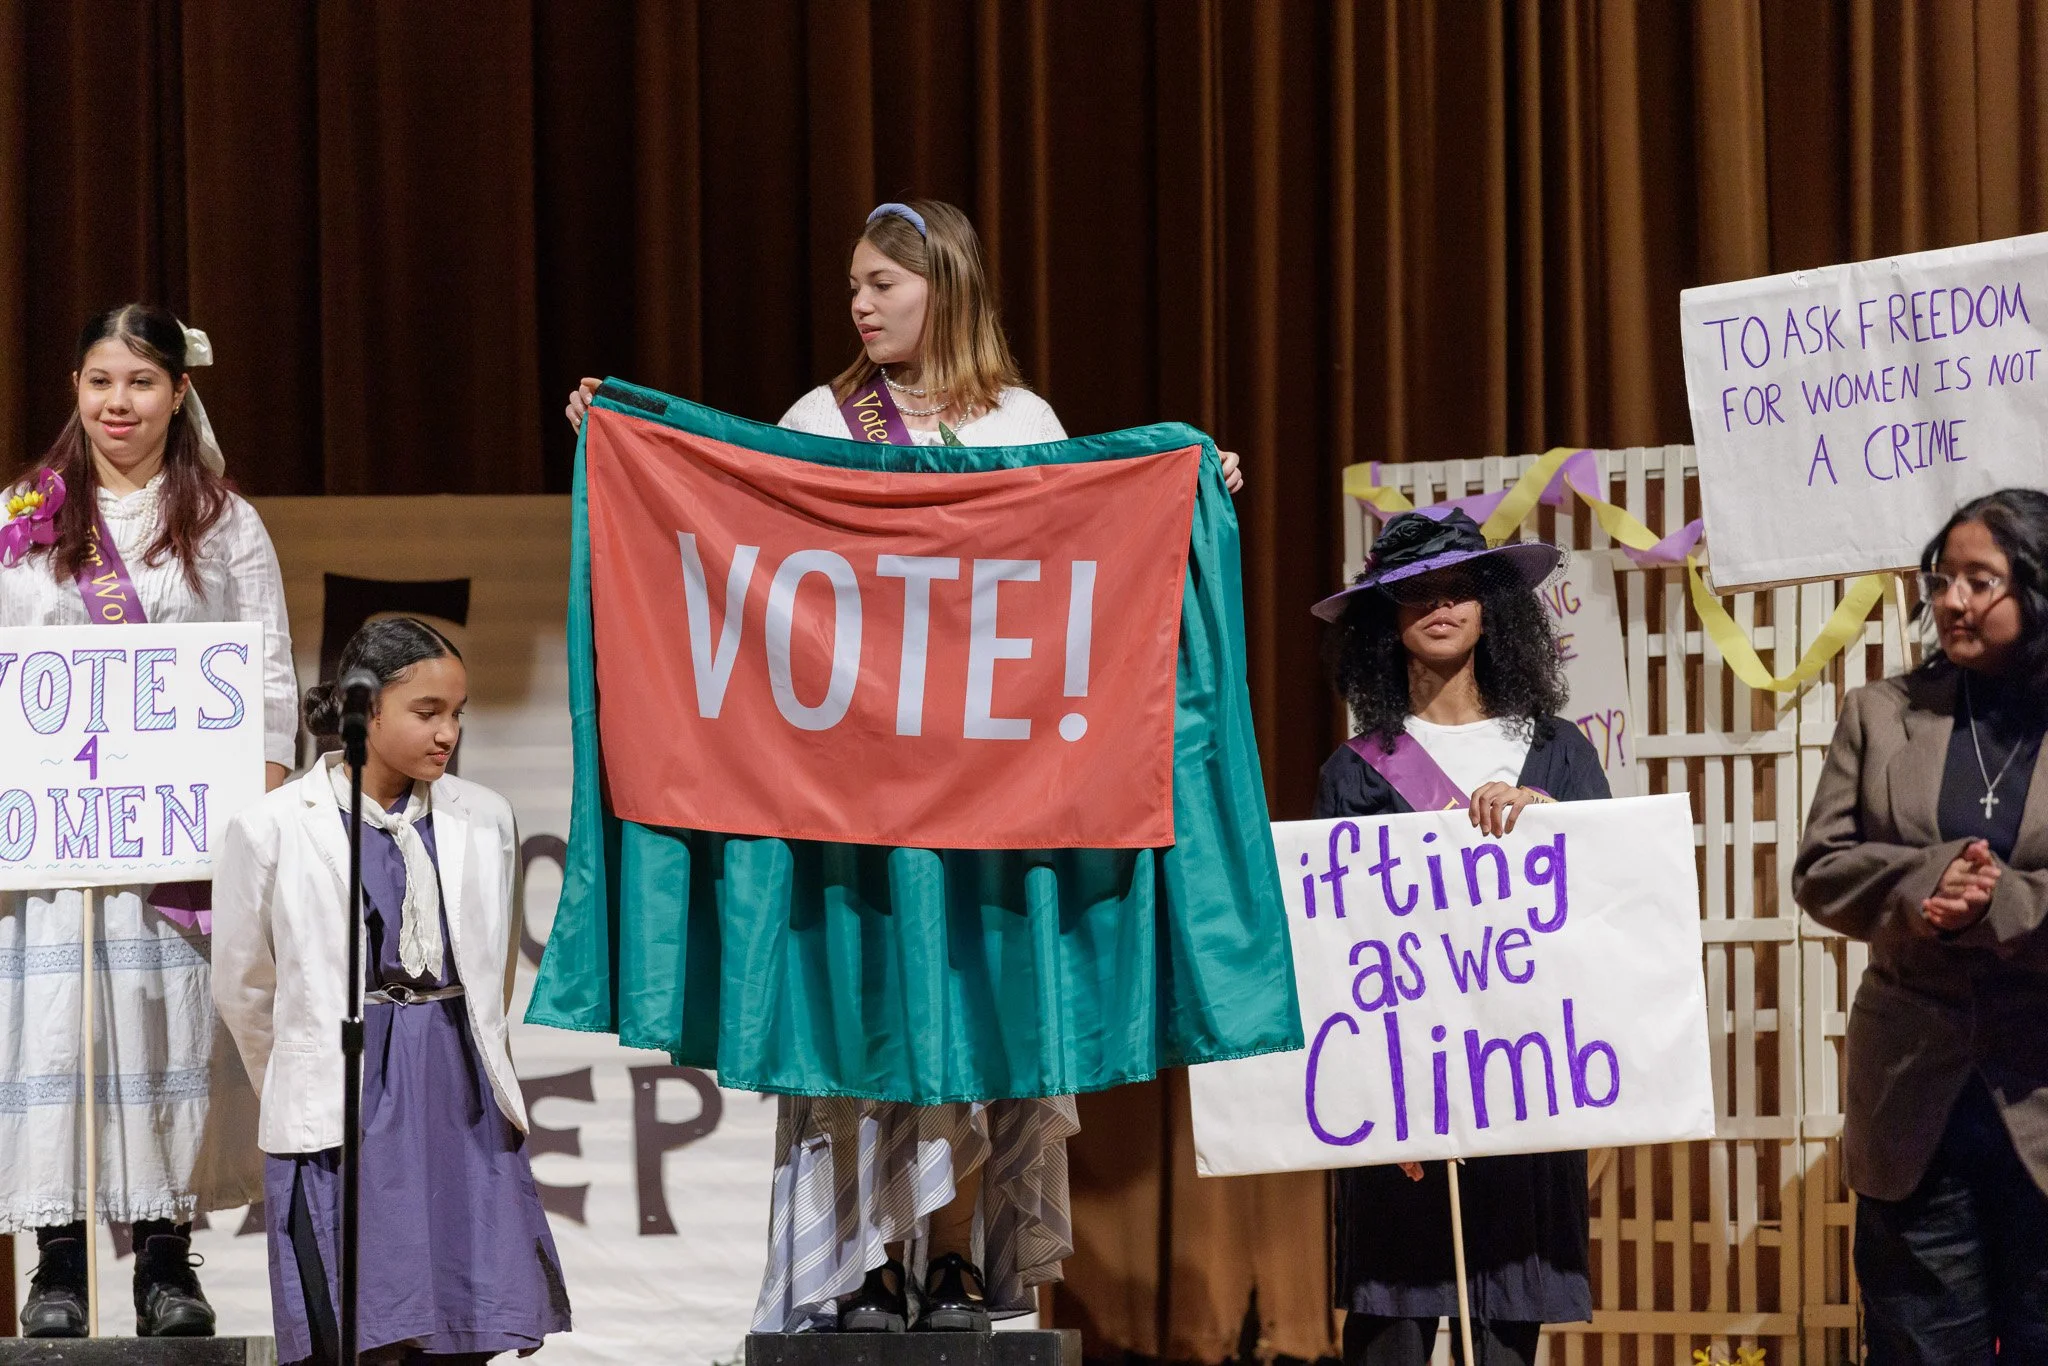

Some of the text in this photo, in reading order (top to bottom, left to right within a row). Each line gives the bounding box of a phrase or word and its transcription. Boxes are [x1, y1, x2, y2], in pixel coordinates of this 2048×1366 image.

[1703, 282, 2031, 371] TO ASK FREEDOM
[853, 390, 892, 445] Vote
[1722, 349, 2042, 432] FOR WOMEN IS NOT
[1807, 418, 1968, 487] A CRIME
[91, 570, 128, 625] Wo
[675, 529, 1098, 743] VOTE!
[74, 734, 99, 780] 4
[1300, 820, 1569, 933] ifting
[1348, 925, 1536, 1012] as we
[1305, 998, 1621, 1147] Climb
